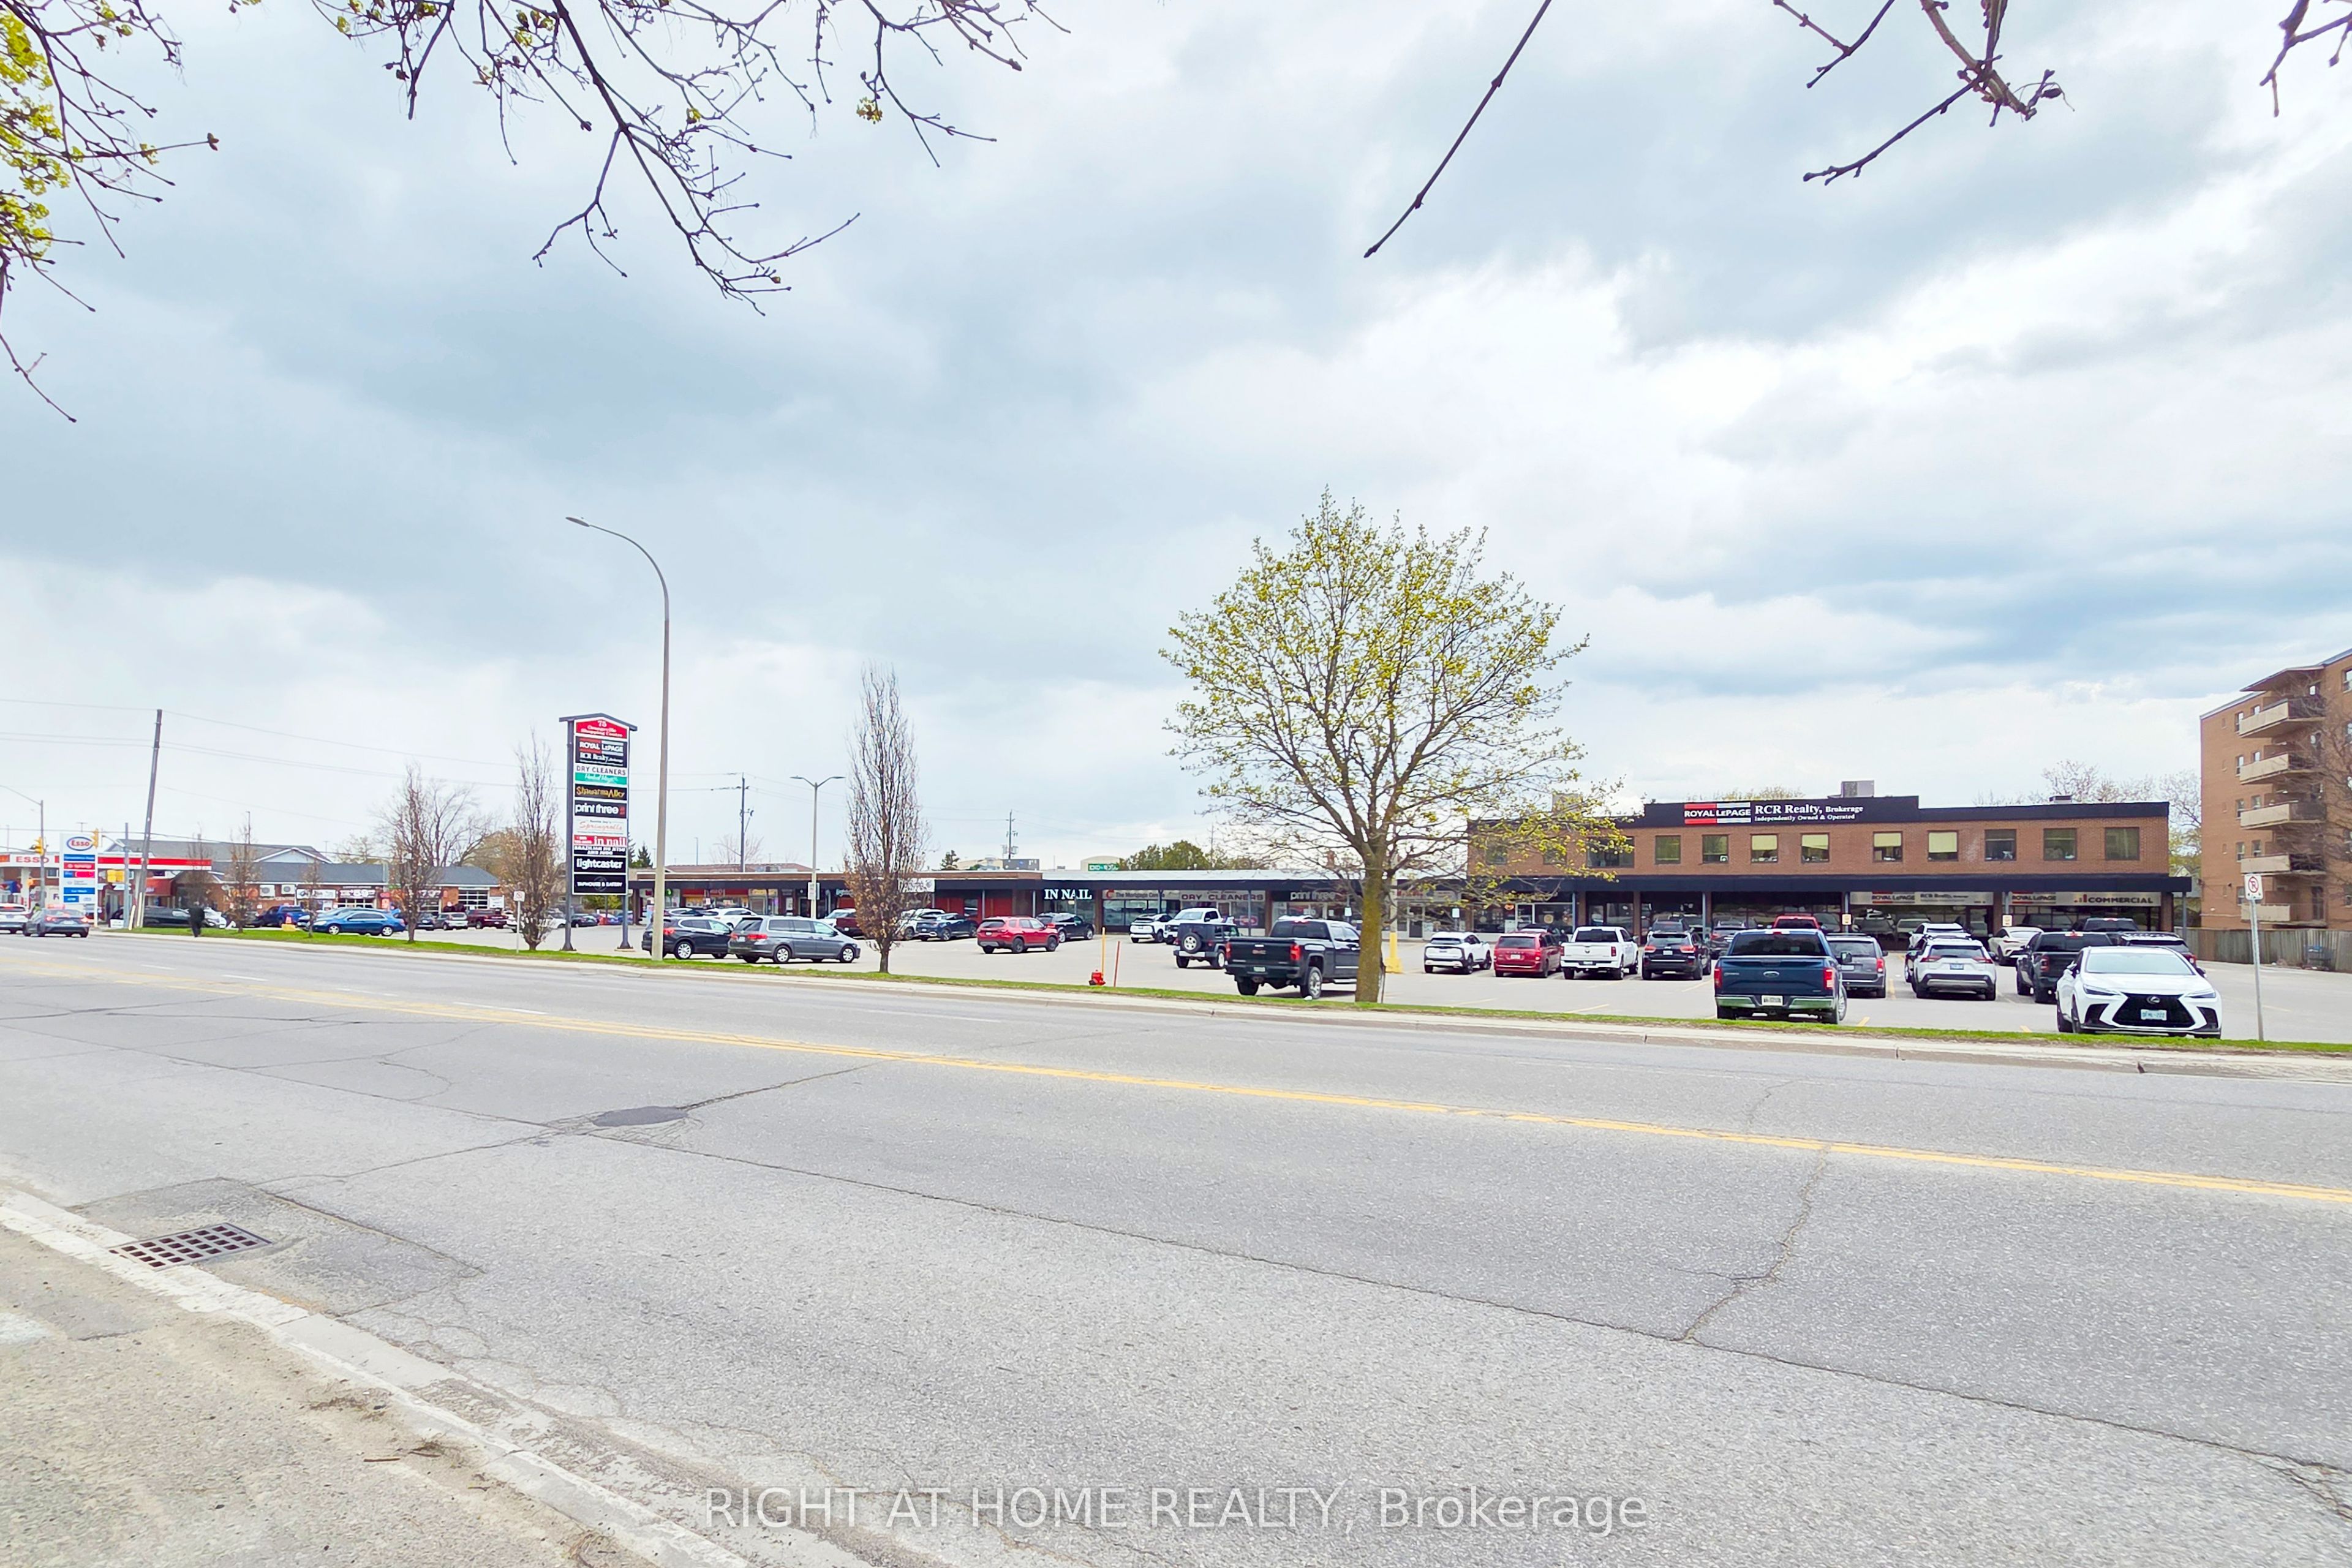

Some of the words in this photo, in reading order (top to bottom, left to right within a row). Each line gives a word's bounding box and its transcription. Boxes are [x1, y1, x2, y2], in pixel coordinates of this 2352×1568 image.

[592, 767, 626, 775] CLEANERS
[575, 803, 595, 813] print
[596, 804, 619, 814] three
[1684, 809, 1714, 818] ROYAL
[1716, 809, 1751, 817] LePAGE
[1755, 805, 1782, 815] RCR
[1784, 804, 1822, 816] Realty,
[1825, 805, 1864, 814] Brokerage
[1044, 889, 1058, 899] IN
[1061, 889, 1092, 900] NAIL
